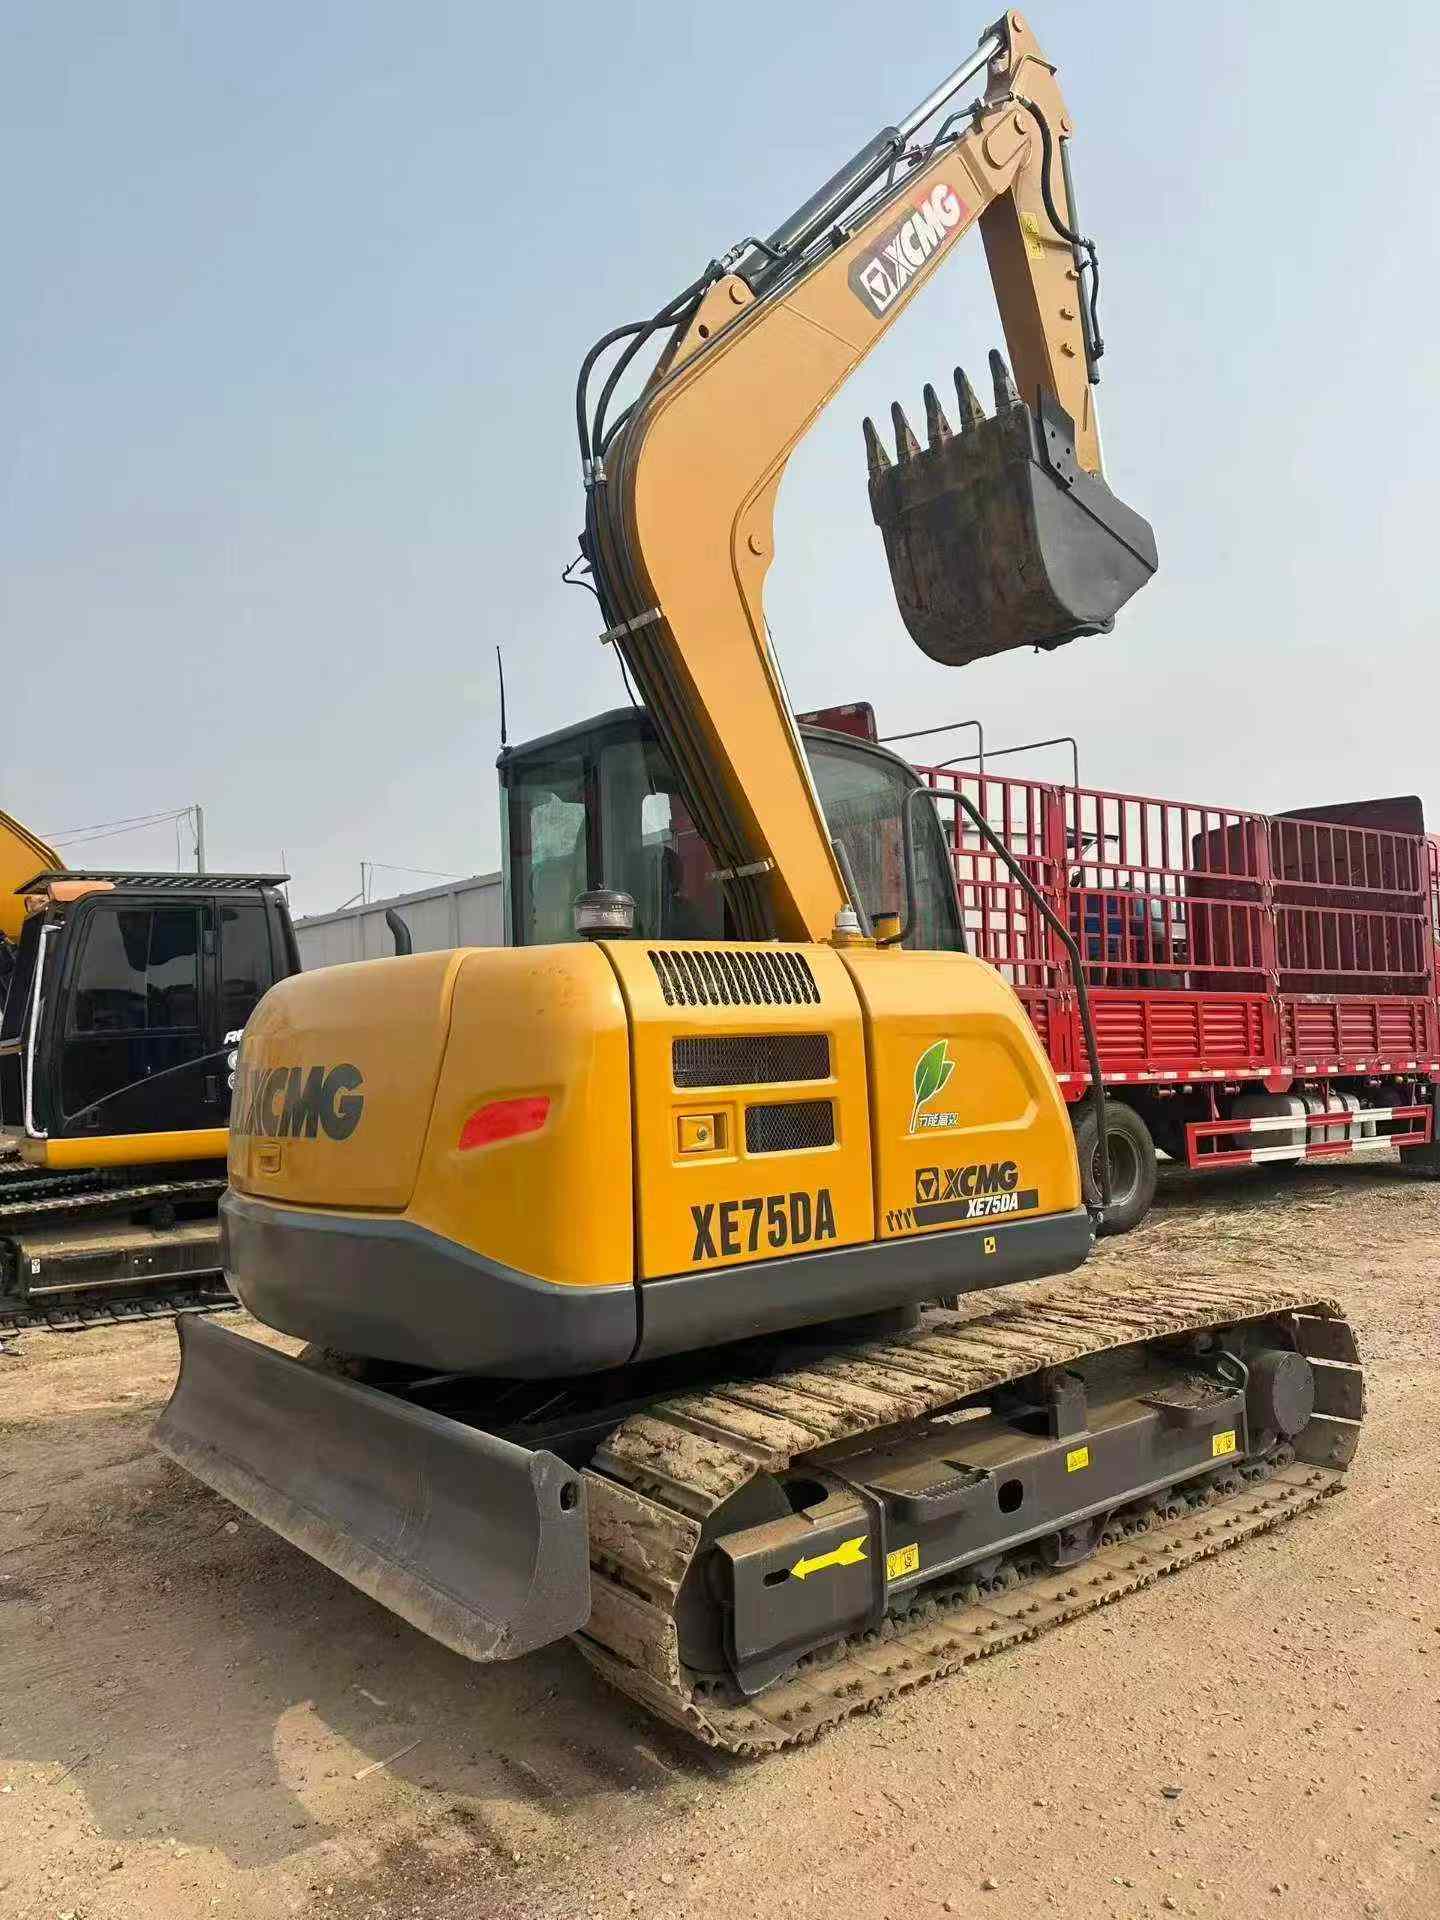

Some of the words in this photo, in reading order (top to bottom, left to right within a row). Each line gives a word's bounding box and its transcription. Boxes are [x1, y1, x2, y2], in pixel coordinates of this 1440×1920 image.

[882, 183, 961, 291] XCMG
[240, 1063, 364, 1141] XCMG
[942, 1160, 1018, 1200] XCMG
[966, 1192, 1019, 1218] XE75DA
[690, 1188, 837, 1261] XE75DA
